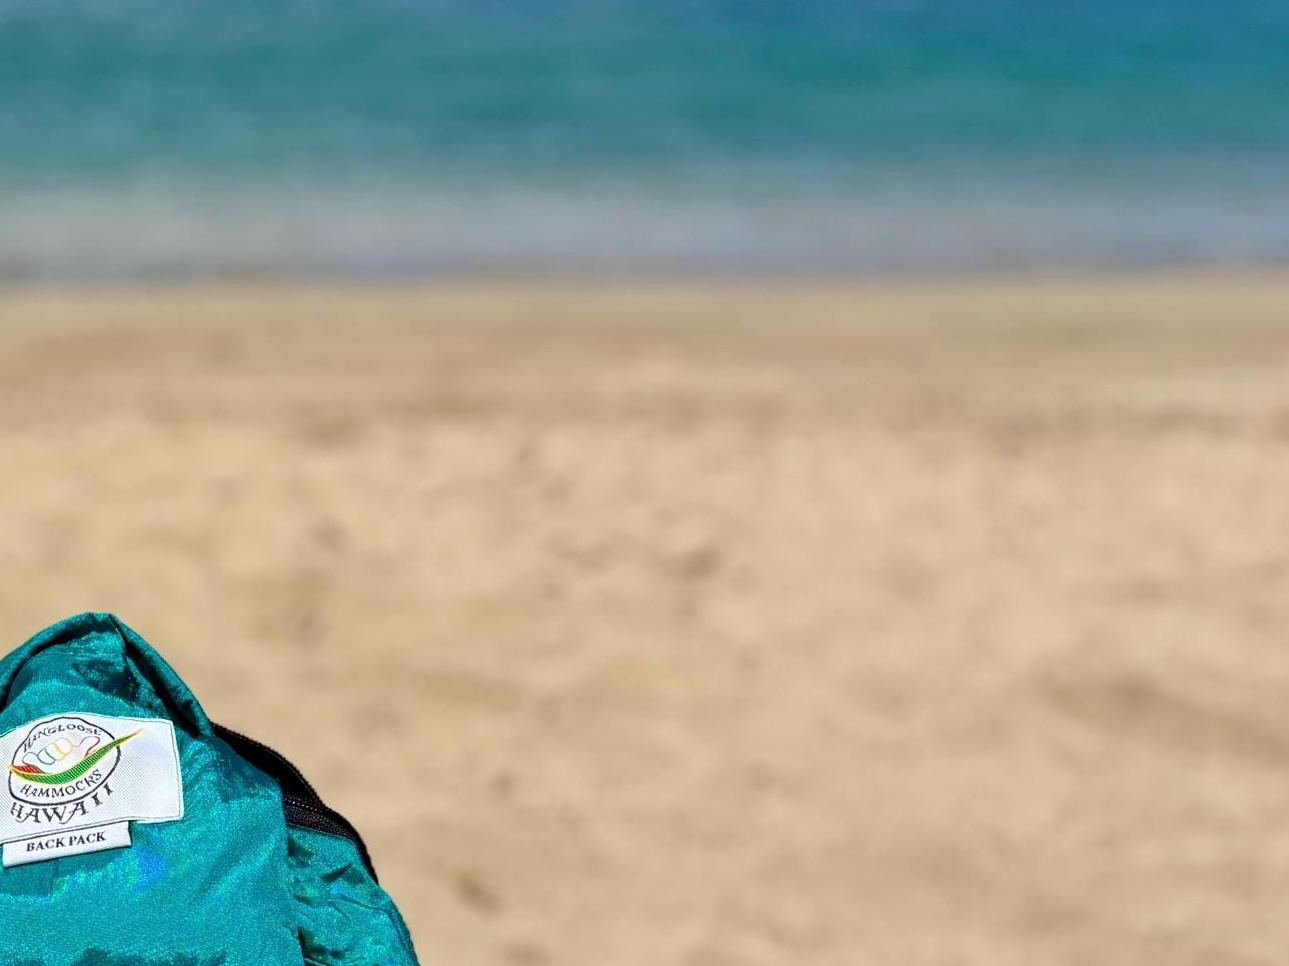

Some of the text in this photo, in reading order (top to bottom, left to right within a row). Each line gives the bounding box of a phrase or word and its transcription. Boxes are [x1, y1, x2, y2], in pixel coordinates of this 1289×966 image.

[20, 769, 102, 798] HAMMOCKS
[10, 782, 114, 824] HAWAII
[26, 831, 106, 852] BACK PACK
